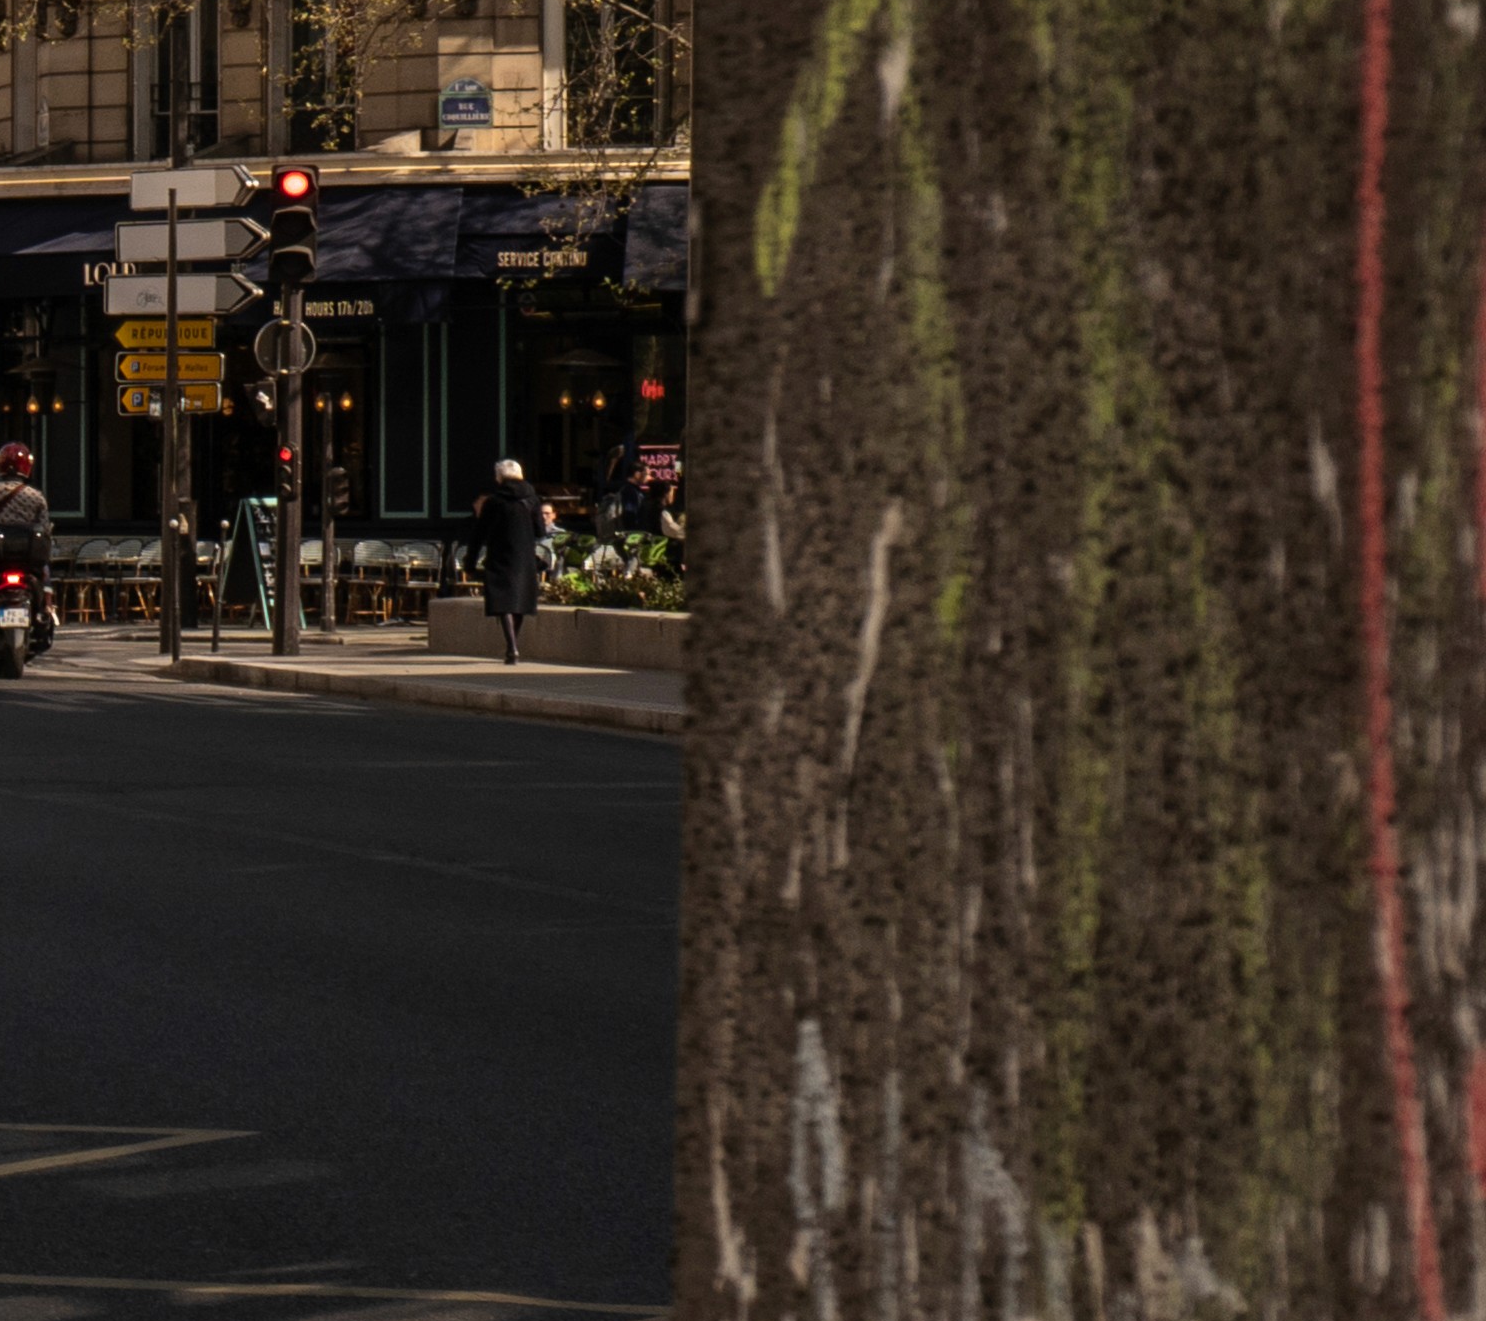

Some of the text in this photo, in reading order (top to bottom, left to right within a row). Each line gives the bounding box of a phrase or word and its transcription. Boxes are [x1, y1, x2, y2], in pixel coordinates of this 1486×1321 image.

[497, 251, 587, 267] SERVICE CONTINU
[305, 301, 335, 316] HOURS
[132, 327, 207, 339] RÉPUIQUE
[640, 454, 678, 466] HAPPY
[649, 468, 680, 481] OURS
